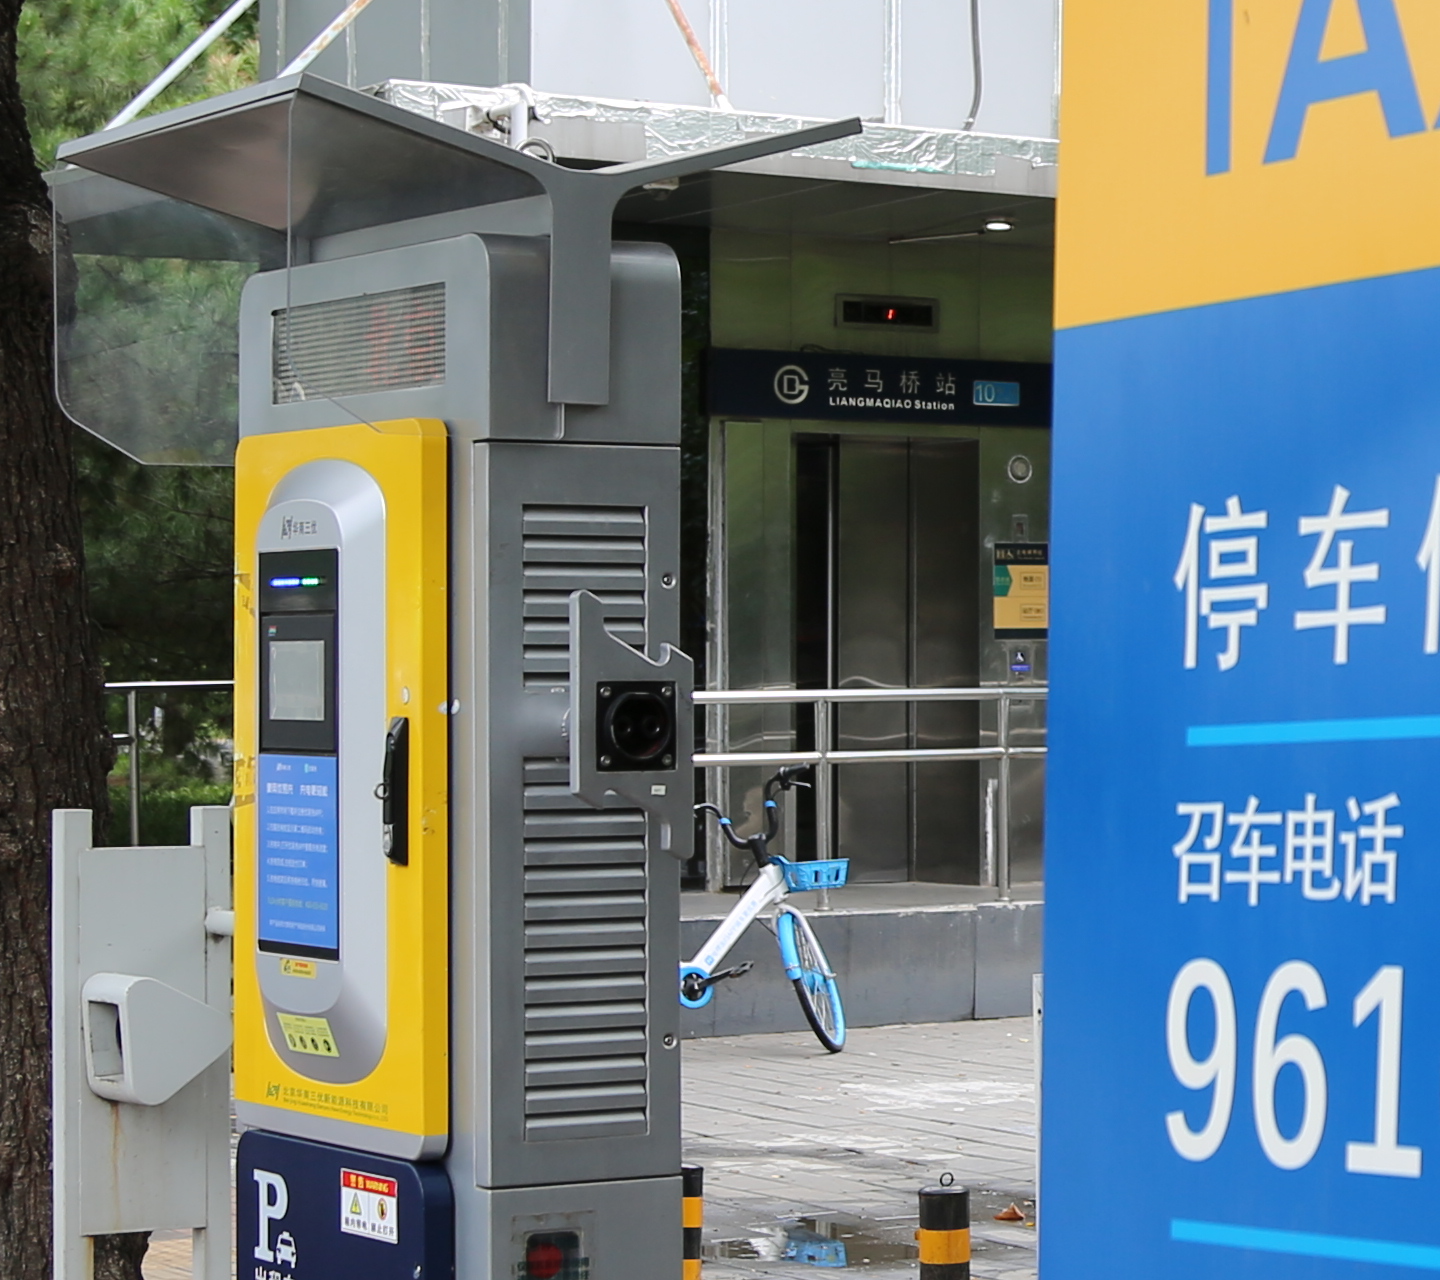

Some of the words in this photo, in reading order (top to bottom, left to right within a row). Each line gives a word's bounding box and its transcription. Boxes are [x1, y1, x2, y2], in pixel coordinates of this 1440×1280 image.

[827, 367, 957, 396] 亮马桥站
[829, 396, 912, 410] LIANGMAQIAO
[914, 399, 956, 411] Station
[1171, 792, 1405, 907] 召车电话
[253, 1168, 289, 1263] P
